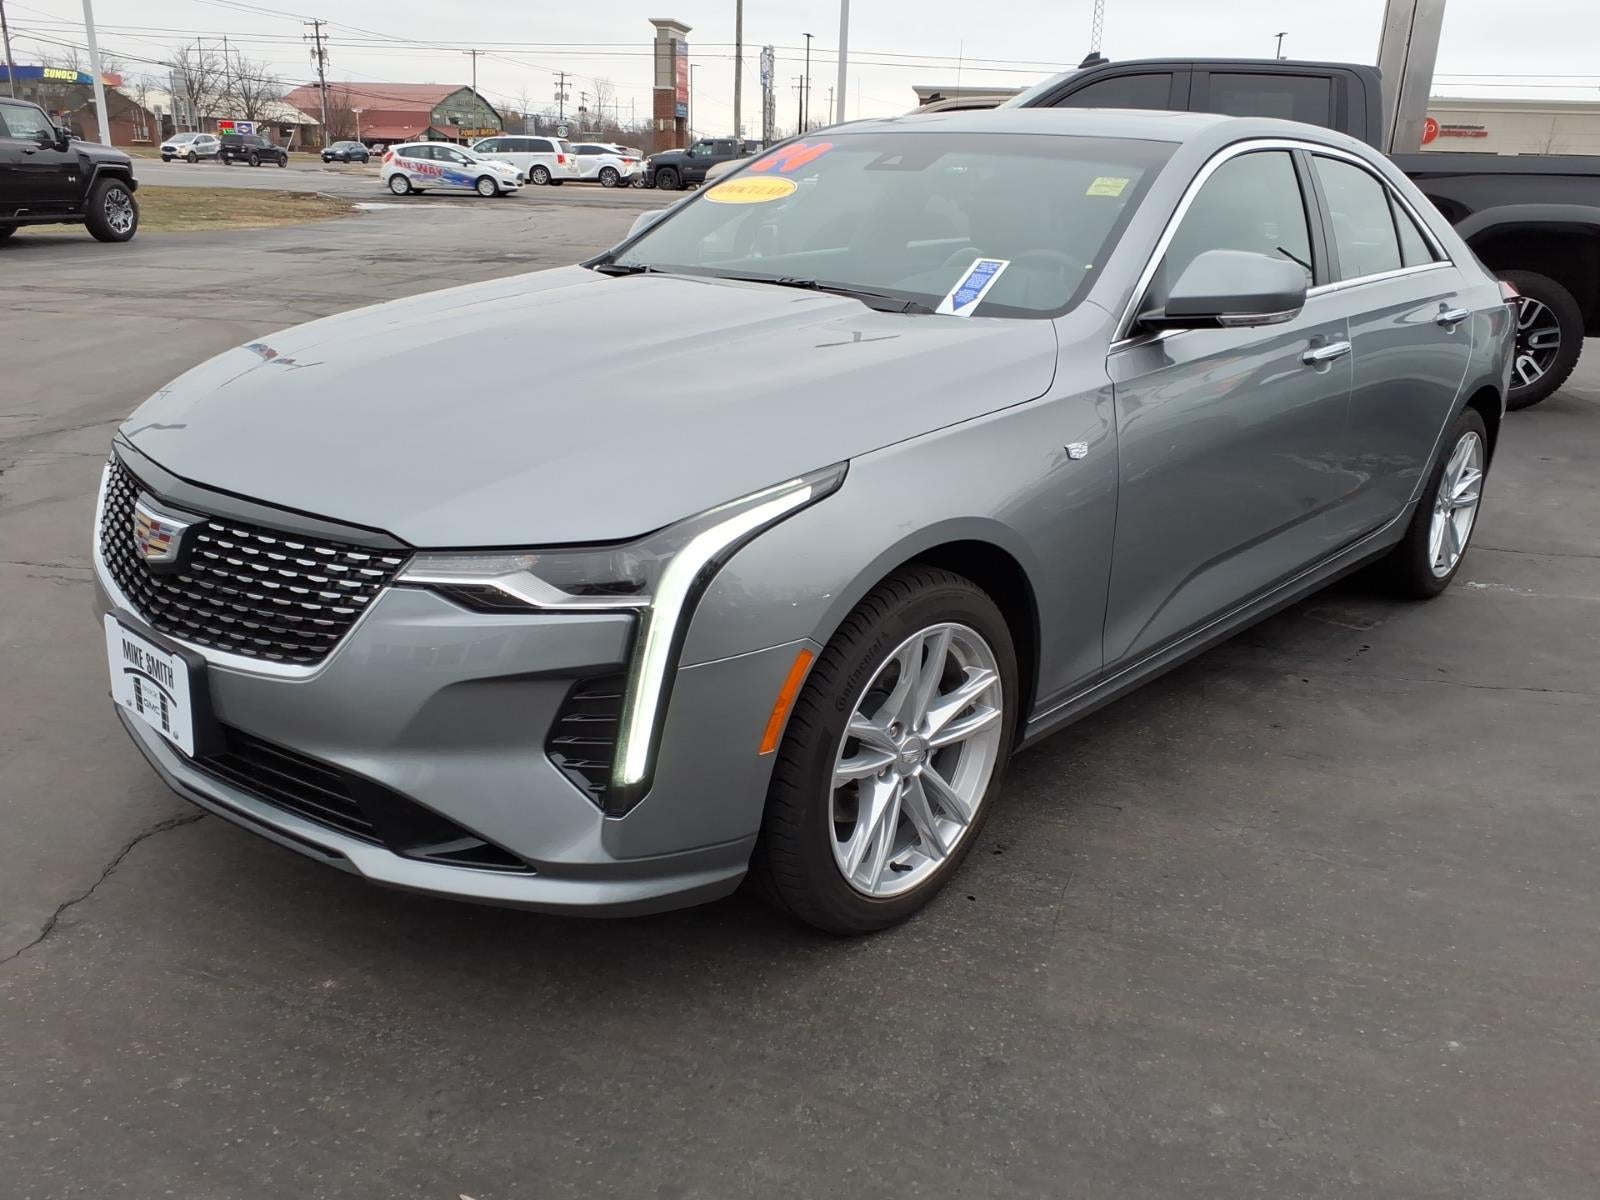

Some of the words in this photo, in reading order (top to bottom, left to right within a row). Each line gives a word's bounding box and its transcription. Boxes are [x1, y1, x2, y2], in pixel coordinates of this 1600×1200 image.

[43, 68, 78, 80] SUNOCO
[122, 638, 144, 670] MIKE
[146, 653, 174, 689] SMITH
